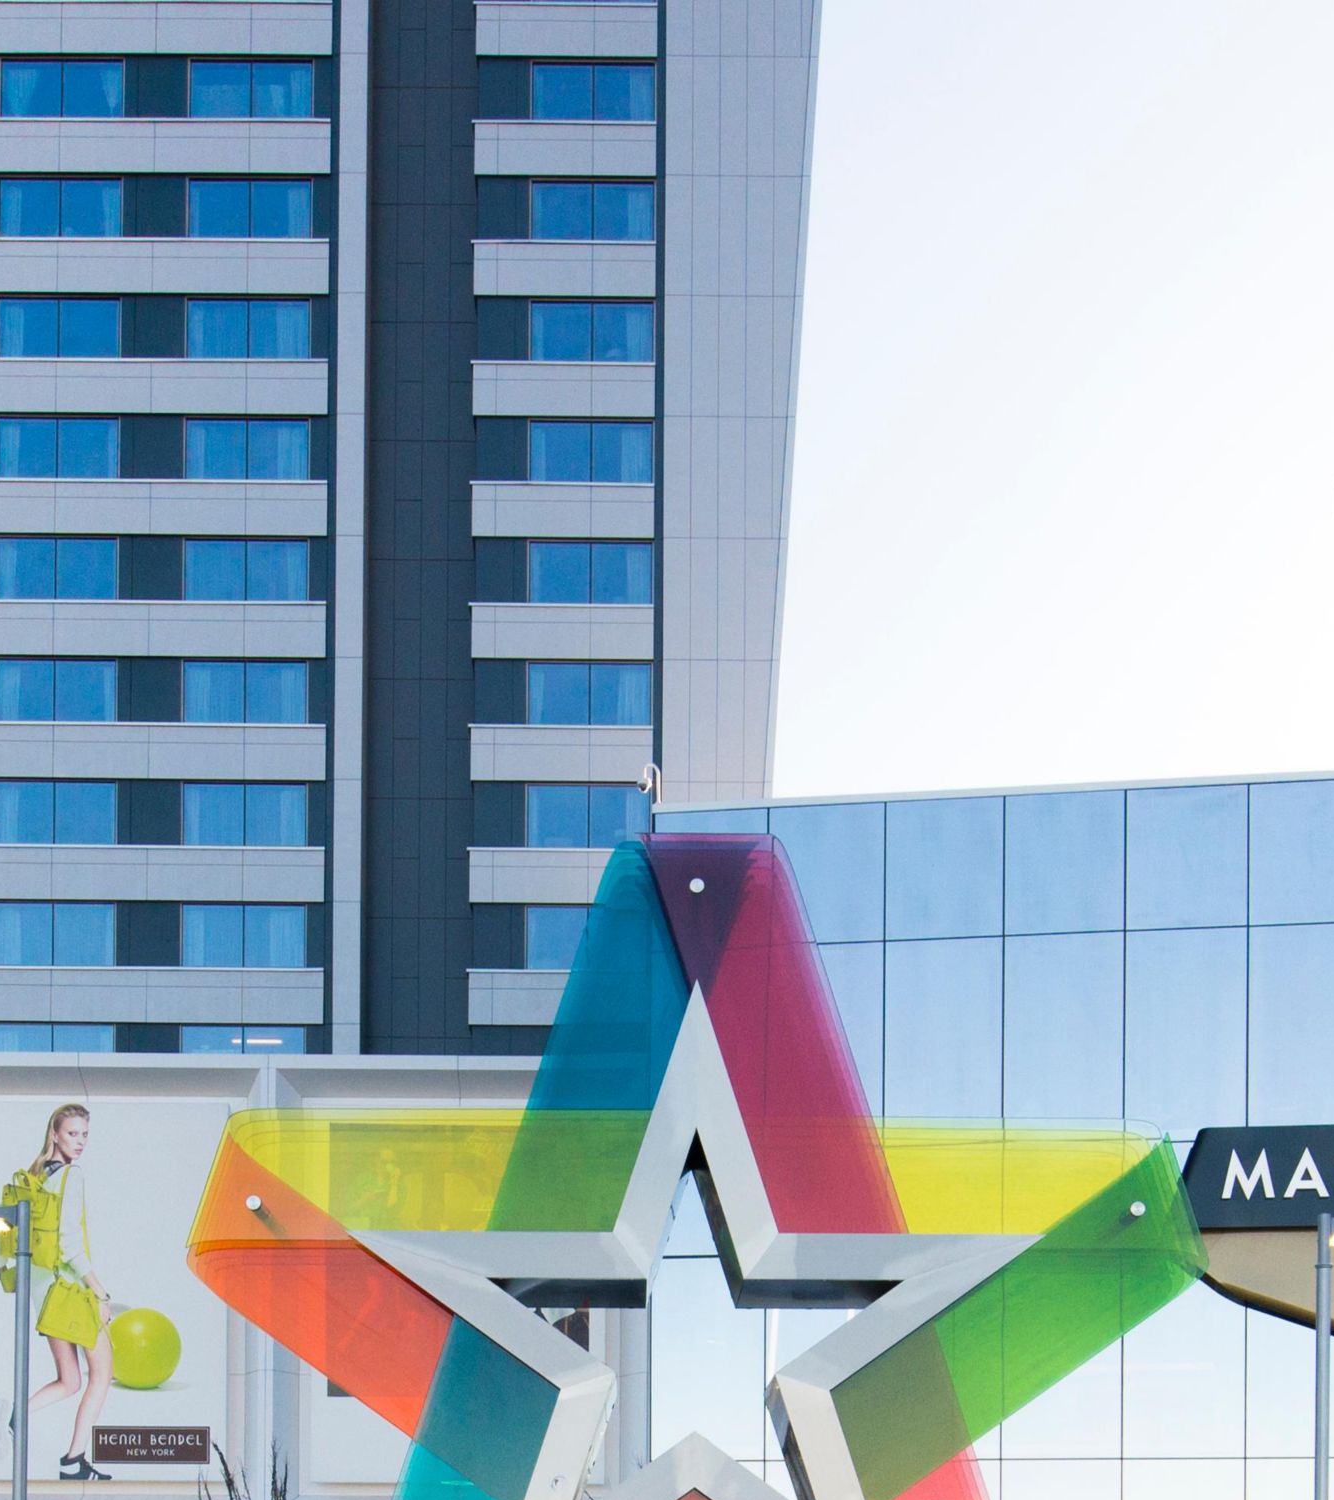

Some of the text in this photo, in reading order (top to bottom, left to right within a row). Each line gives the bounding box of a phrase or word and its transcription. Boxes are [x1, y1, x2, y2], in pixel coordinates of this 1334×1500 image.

[99, 1434, 203, 1446] HENRI BENDEL
[126, 1448, 175, 1456] NEW YORK
